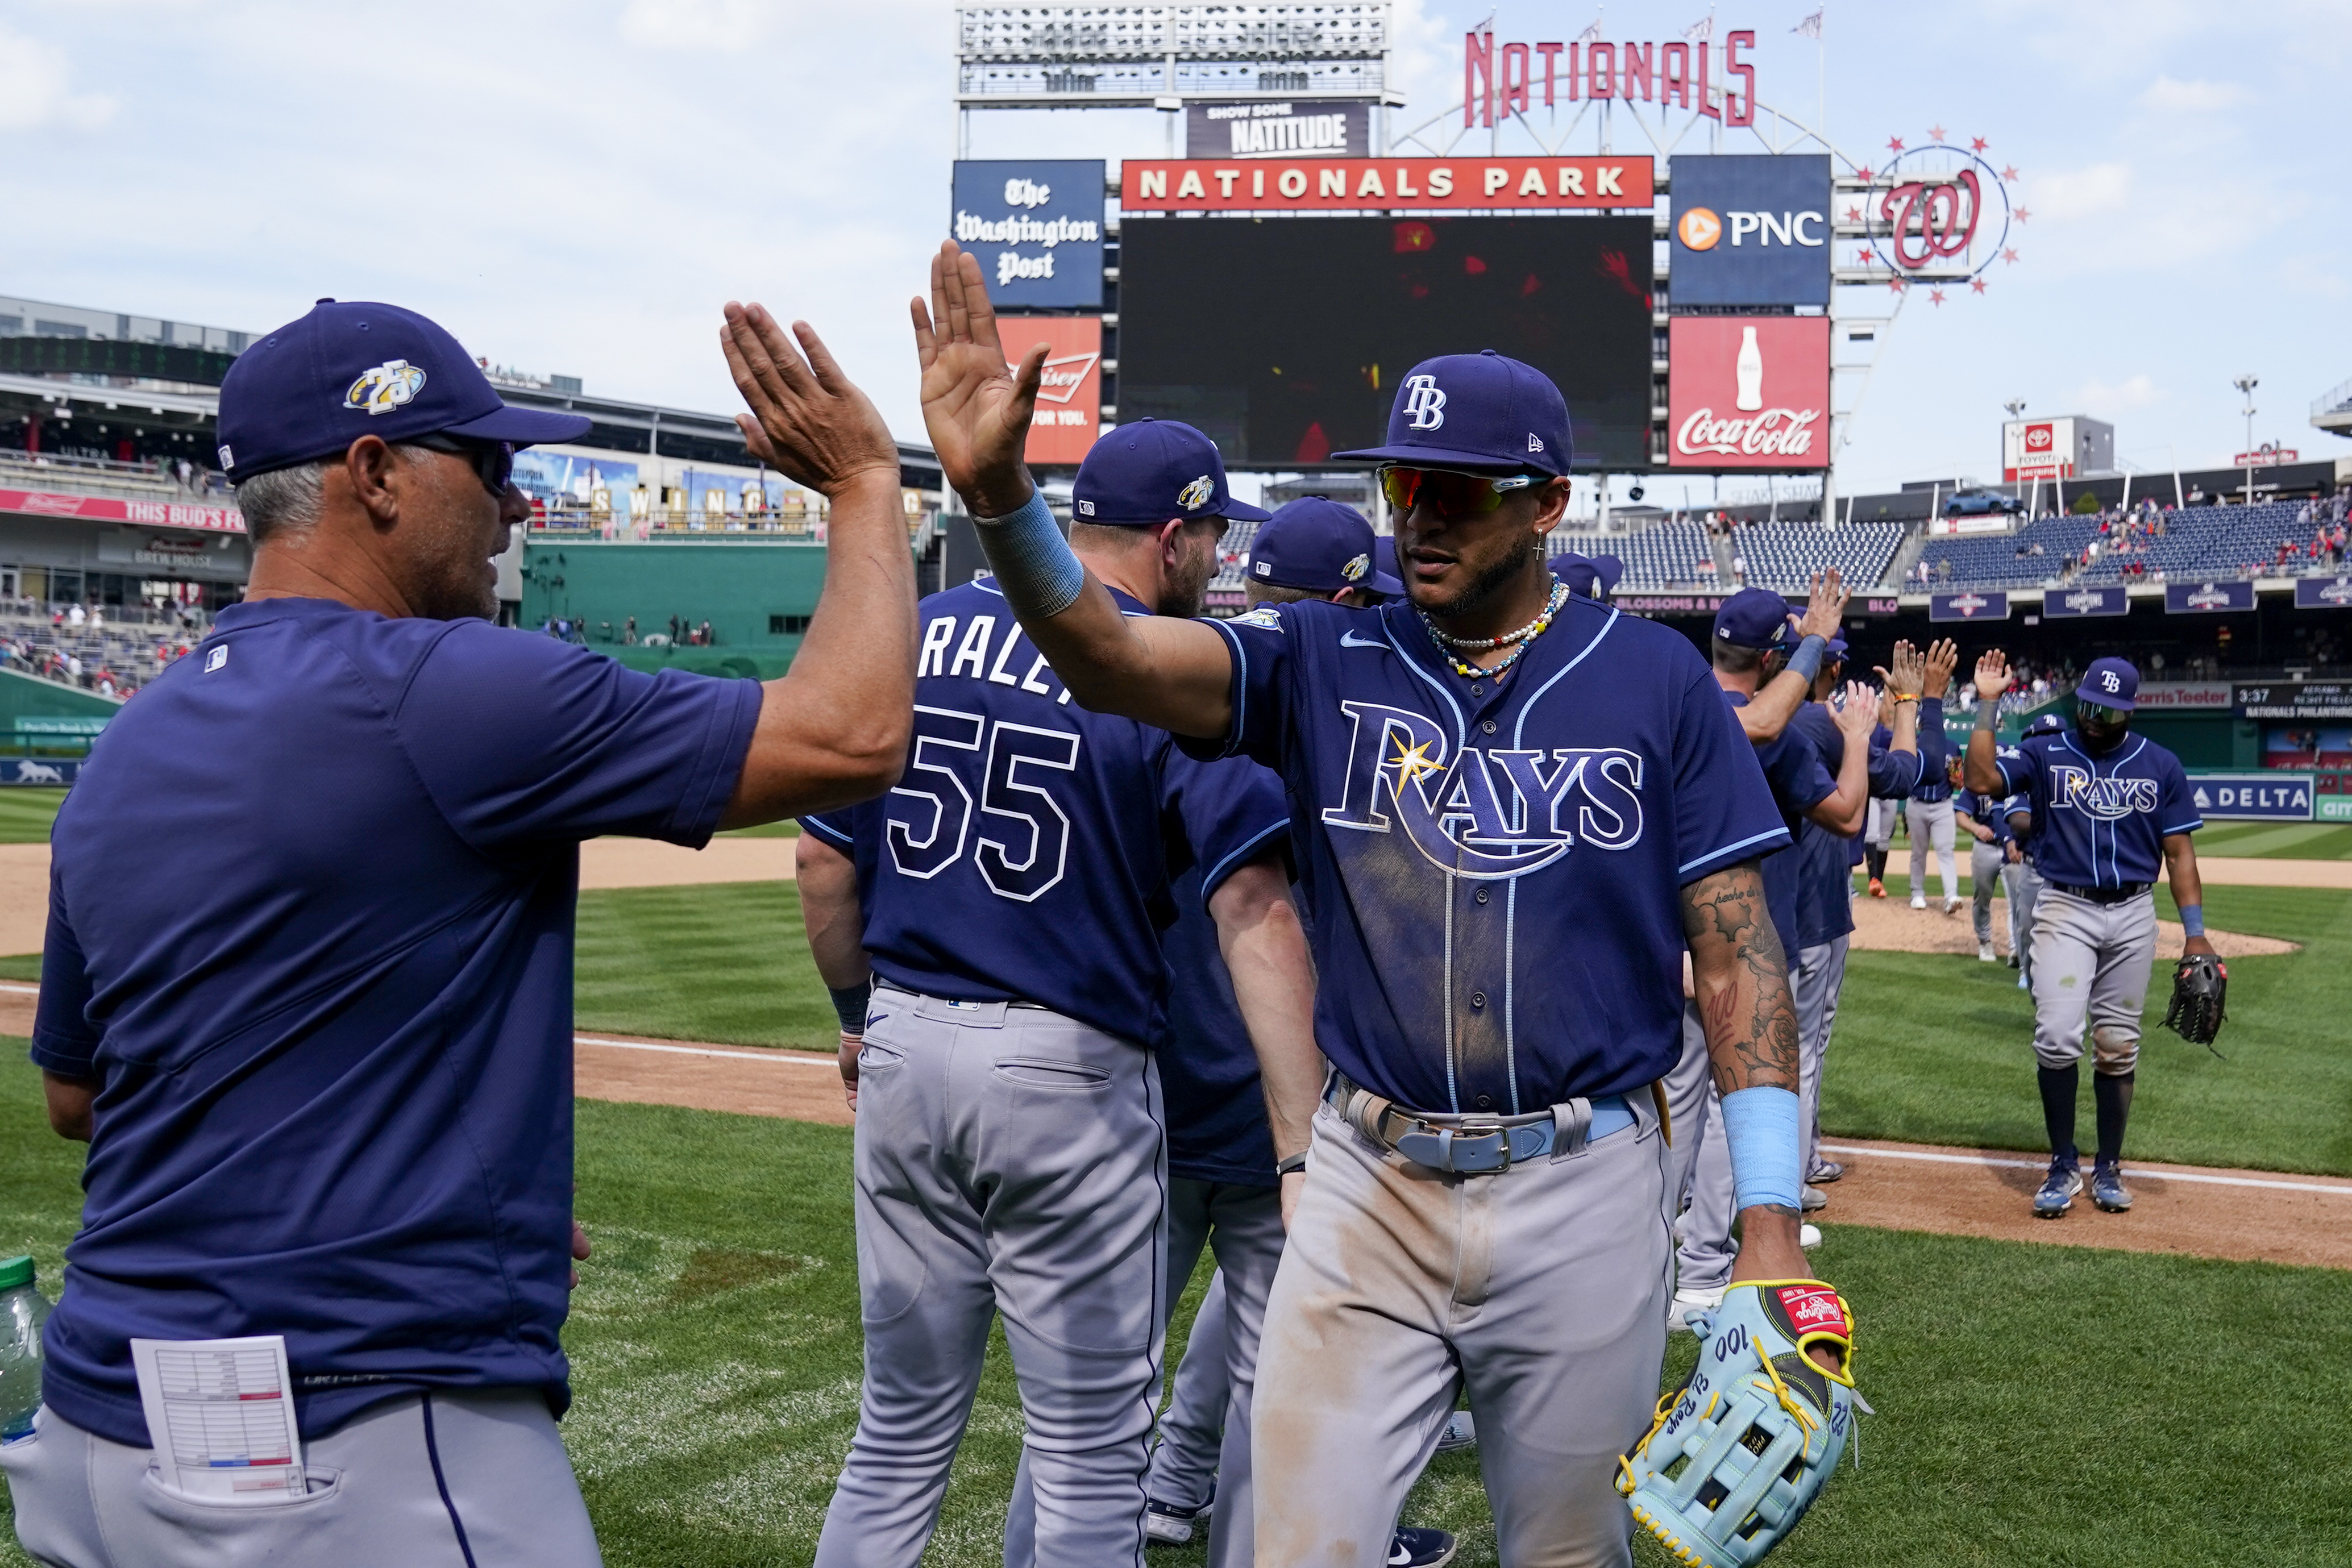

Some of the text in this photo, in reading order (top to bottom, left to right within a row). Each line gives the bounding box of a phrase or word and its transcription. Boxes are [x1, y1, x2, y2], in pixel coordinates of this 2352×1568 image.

[1465, 30, 1755, 127] NATIONALS
[1207, 103, 1293, 119] SHOW SOME
[1230, 113, 1348, 153] NATITUDE
[1004, 178, 1051, 210] The
[1140, 167, 1626, 199] NATIONALS PARK
[954, 209, 1099, 248] Washington
[1727, 210, 1823, 247] PNC
[996, 251, 1055, 287] Post
[1030, 409, 1088, 426] FOR YOU.
[1403, 374, 1447, 431] TB
[1677, 407, 1821, 456] Coca-Cola
[2019, 455, 2060, 464] TOYOTA
[126, 501, 246, 530] THIS BUD'S FO
[1616, 597, 1693, 611] BLOSSOMS
[1696, 597, 1706, 610] &
[1868, 599, 1898, 612] BLO
[916, 615, 1072, 705] RALE
[2101, 669, 2121, 693] TB
[2135, 688, 2227, 704] arris Teeter
[2238, 688, 2270, 703] 3:37
[2246, 706, 2296, 718] NATIONALS
[886, 704, 1081, 902] 55
[2218, 787, 2309, 808] DELTA
[1795, 1301, 1841, 1321] Rawlings
[1714, 1323, 1749, 1362] 100
[1665, 1371, 1709, 1436] El Rayo
